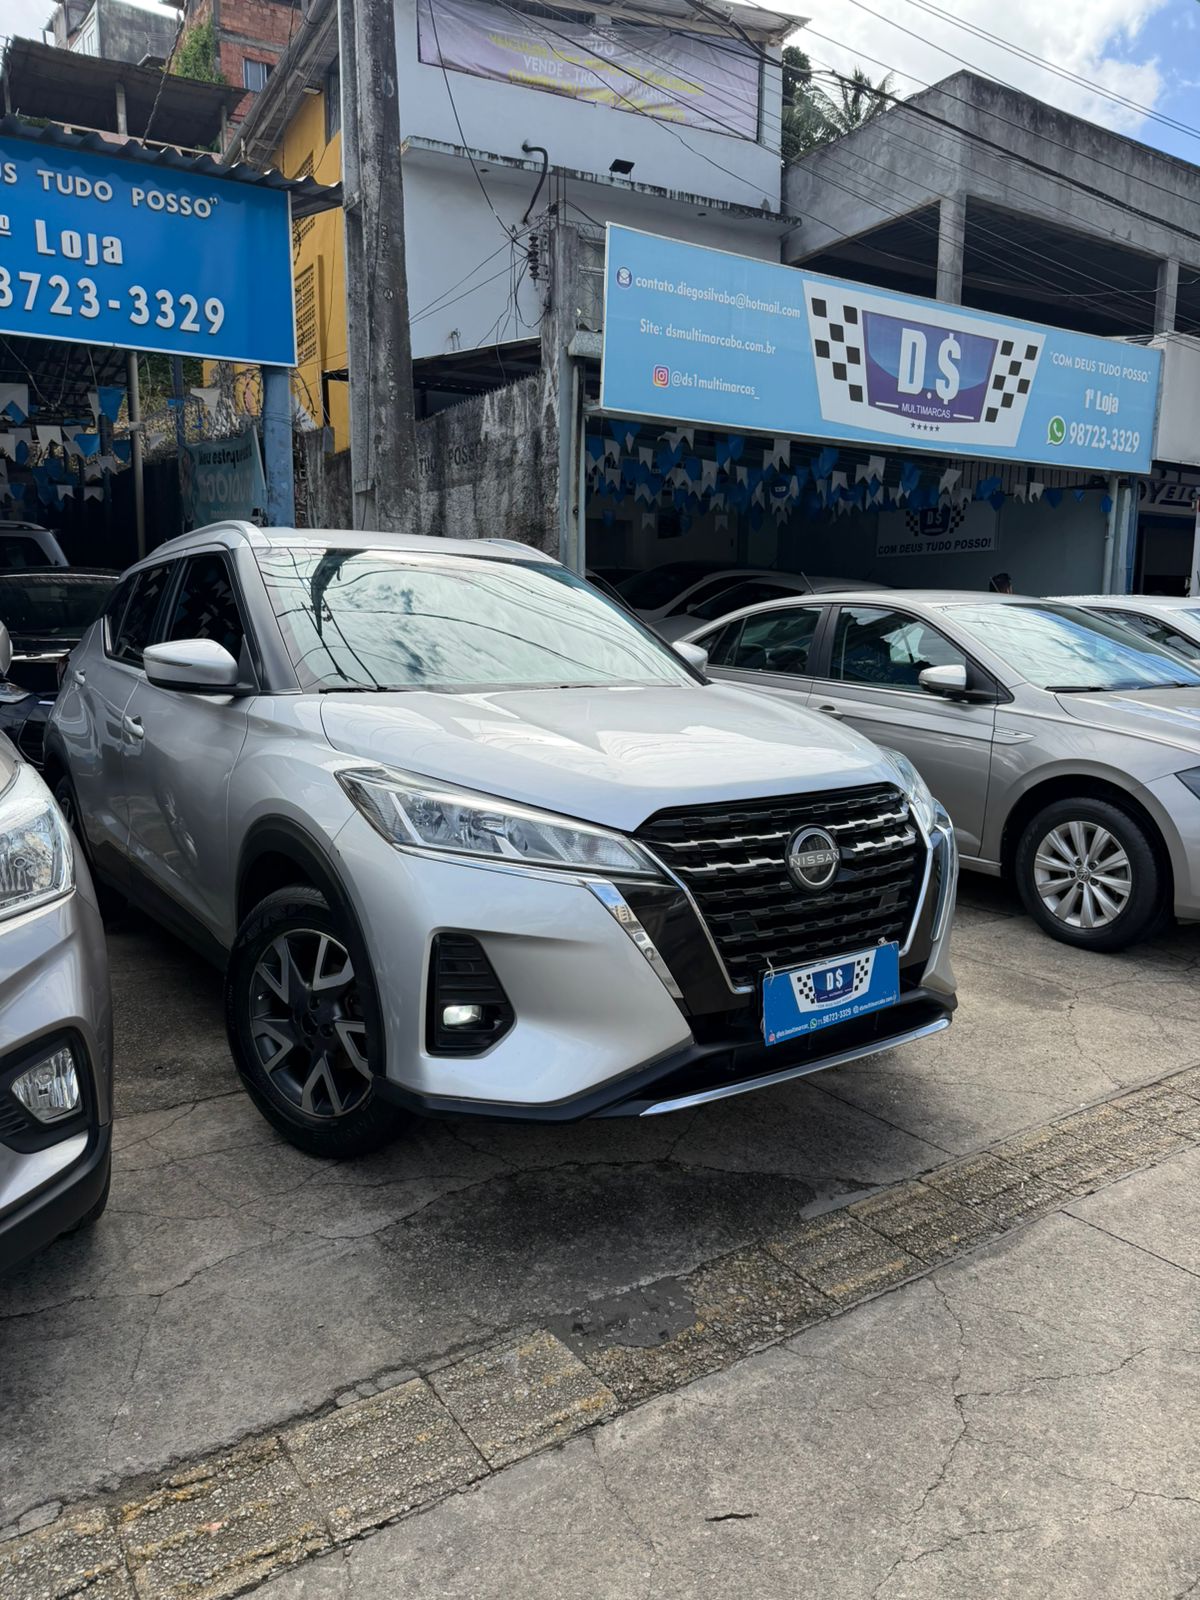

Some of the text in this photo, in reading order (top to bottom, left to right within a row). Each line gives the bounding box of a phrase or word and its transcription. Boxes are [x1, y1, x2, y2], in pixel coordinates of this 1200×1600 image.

[524, 55, 564, 78] VENDE
[37, 169, 113, 202] TUDO
[35, 219, 124, 266] Loja
[640, 318, 663, 336] Site:
[1074, 357, 1097, 372] DEUS
[1097, 362, 1121, 377] TUDO
[901, 403, 951, 419] MULTIMARCAS
[1095, 390, 1120, 415] Loja
[1069, 421, 1140, 453] 98723-3329
[878, 538, 992, 555] COM DEUS TUDO POSSO!
[790, 850, 840, 867] NISSAN
